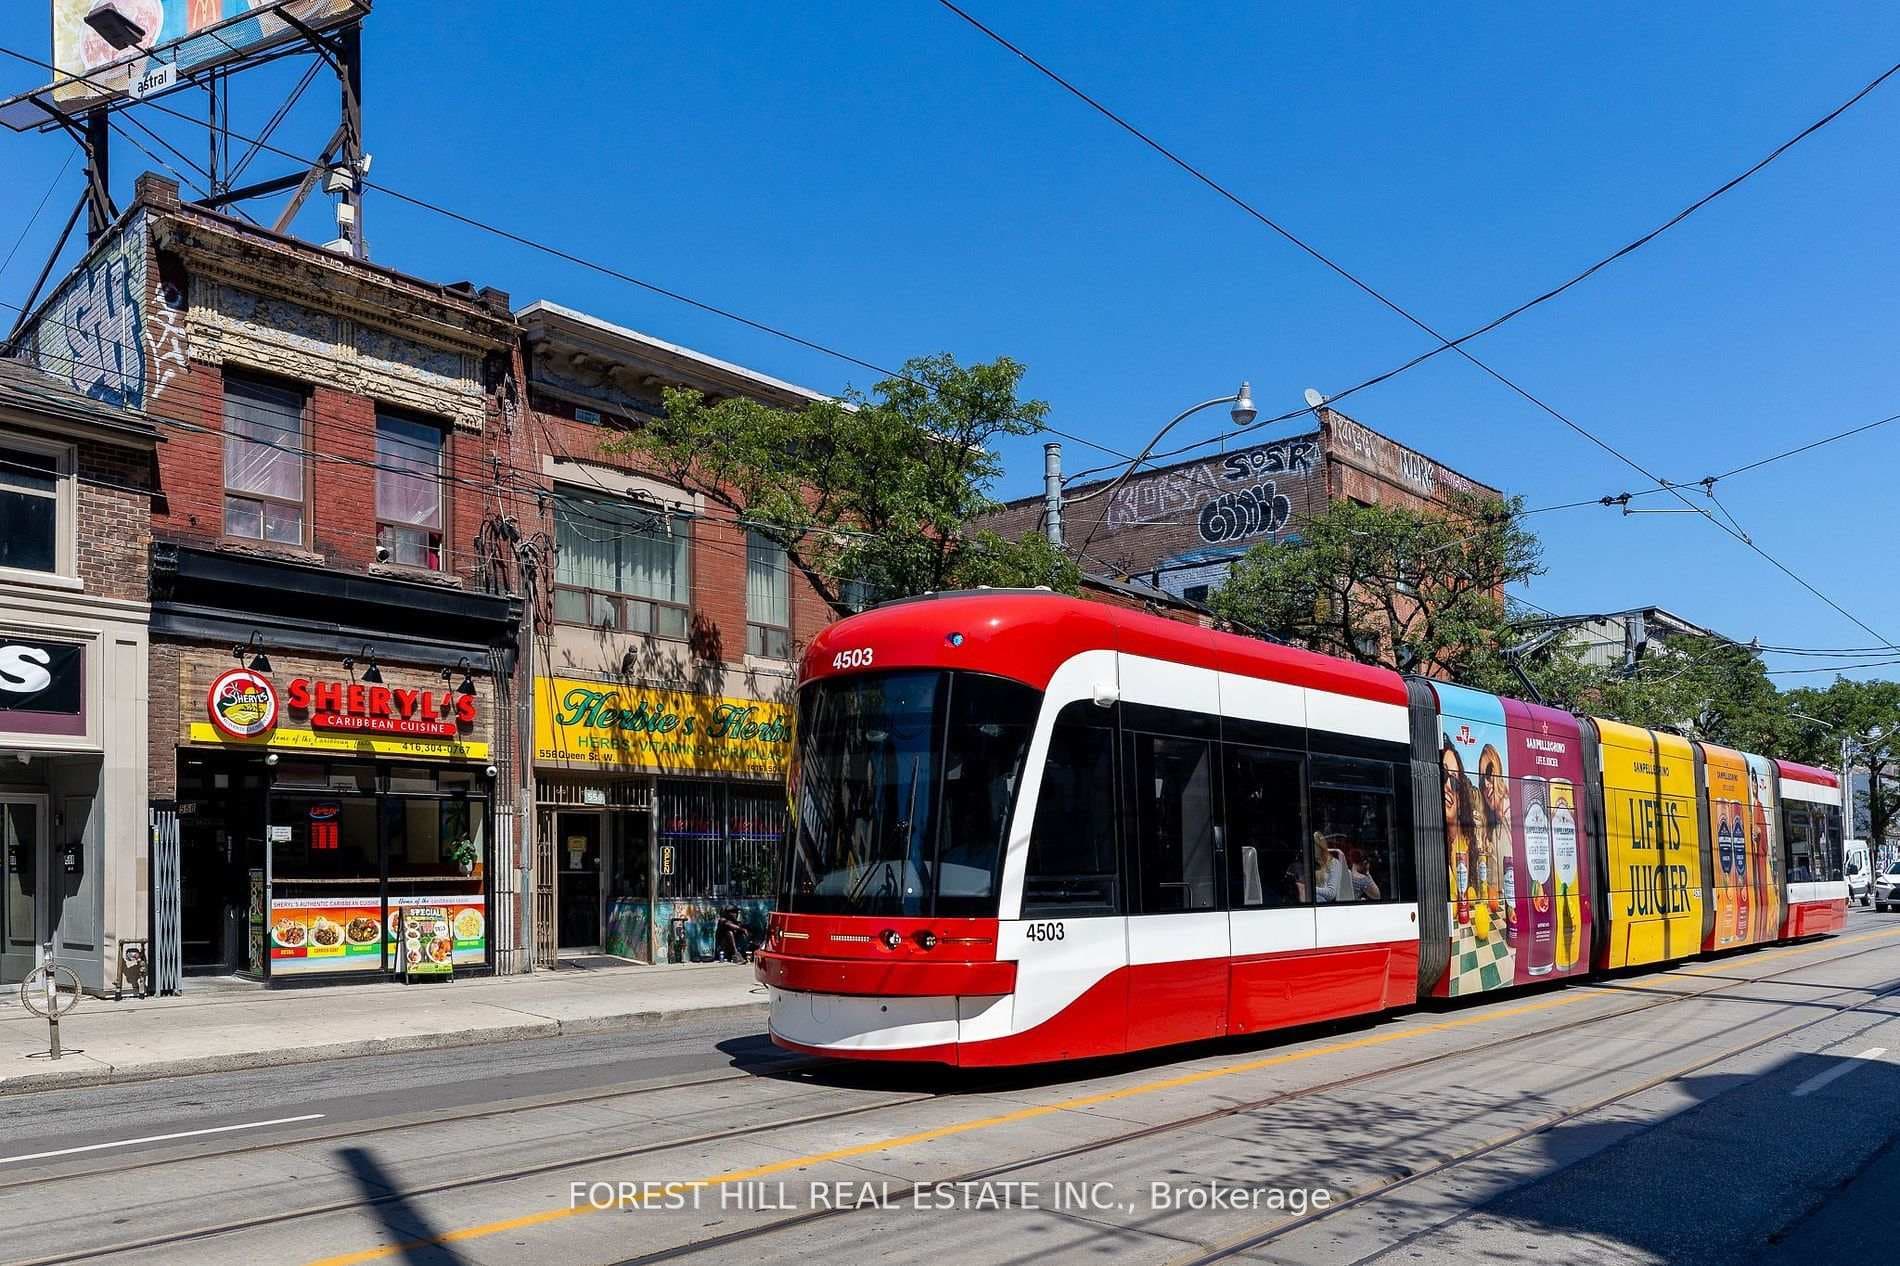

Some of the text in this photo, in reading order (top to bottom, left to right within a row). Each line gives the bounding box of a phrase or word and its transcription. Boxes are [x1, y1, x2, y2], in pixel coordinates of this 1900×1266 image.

[137, 70, 167, 93] astral
[832, 647, 873, 670] 4503
[288, 678, 477, 722] SHERYL'S
[327, 716, 445, 732] CARIBBEAN CUISINE
[558, 750, 586, 760] Queen
[604, 753, 616, 762] W.
[578, 735, 630, 752] HERBS
[639, 740, 705, 757] VITAMINS
[1629, 798, 1665, 849] LIFE
[1666, 800, 1681, 851] IS
[663, 847, 671, 874] OPEN
[1627, 864, 1691, 917] JUICIER
[410, 908, 441, 916] SPECIAL
[1026, 921, 1065, 942] 4503
